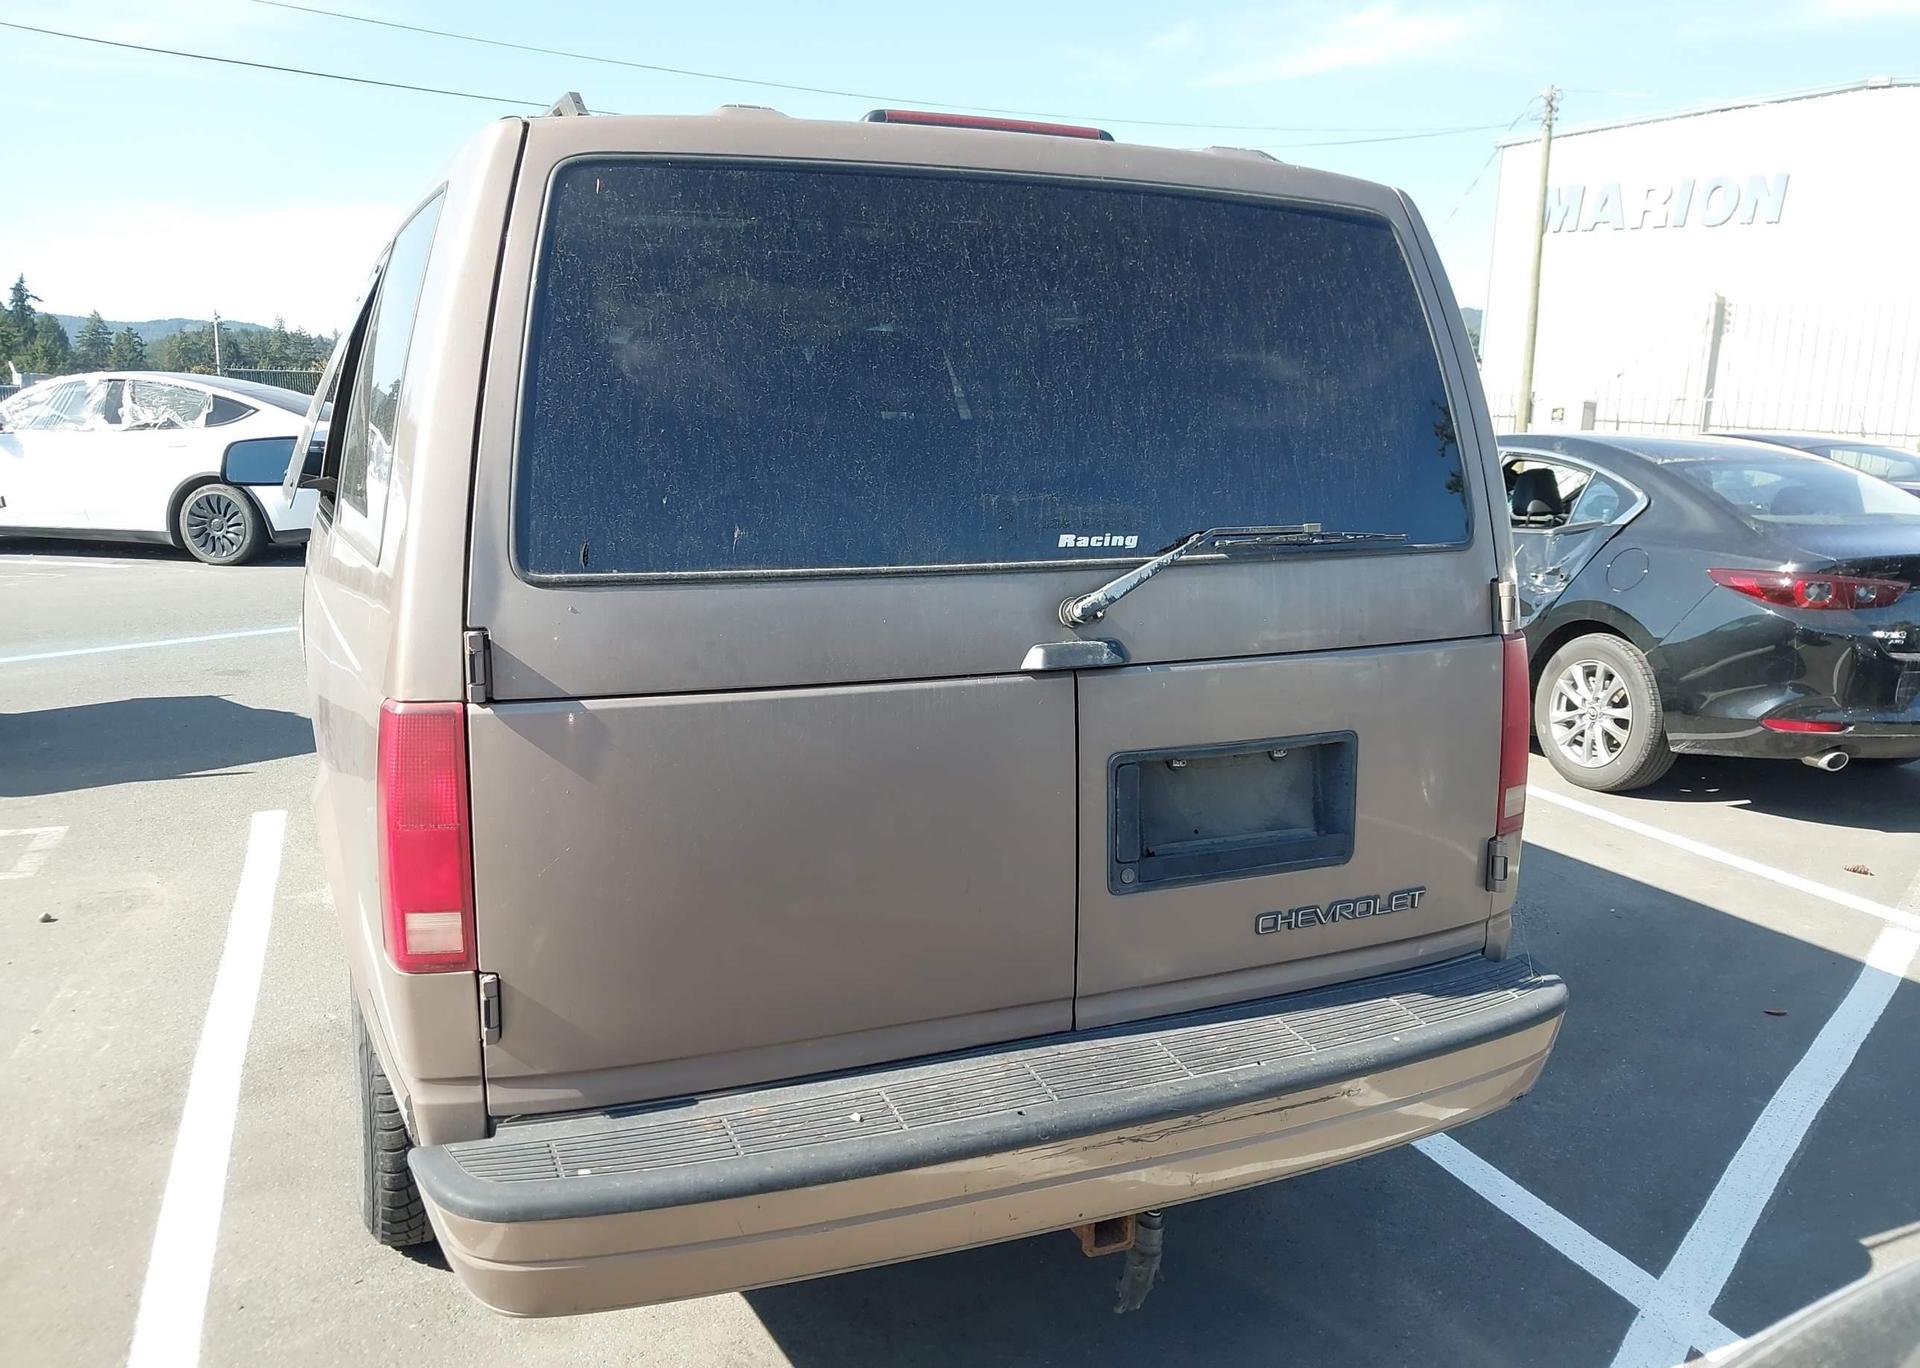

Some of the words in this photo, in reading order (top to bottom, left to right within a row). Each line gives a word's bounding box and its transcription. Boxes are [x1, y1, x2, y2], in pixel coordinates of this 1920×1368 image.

[1543, 173, 1790, 233] MARION
[1058, 533, 1138, 548] Racing
[1255, 885, 1426, 935] CHEVROLET
